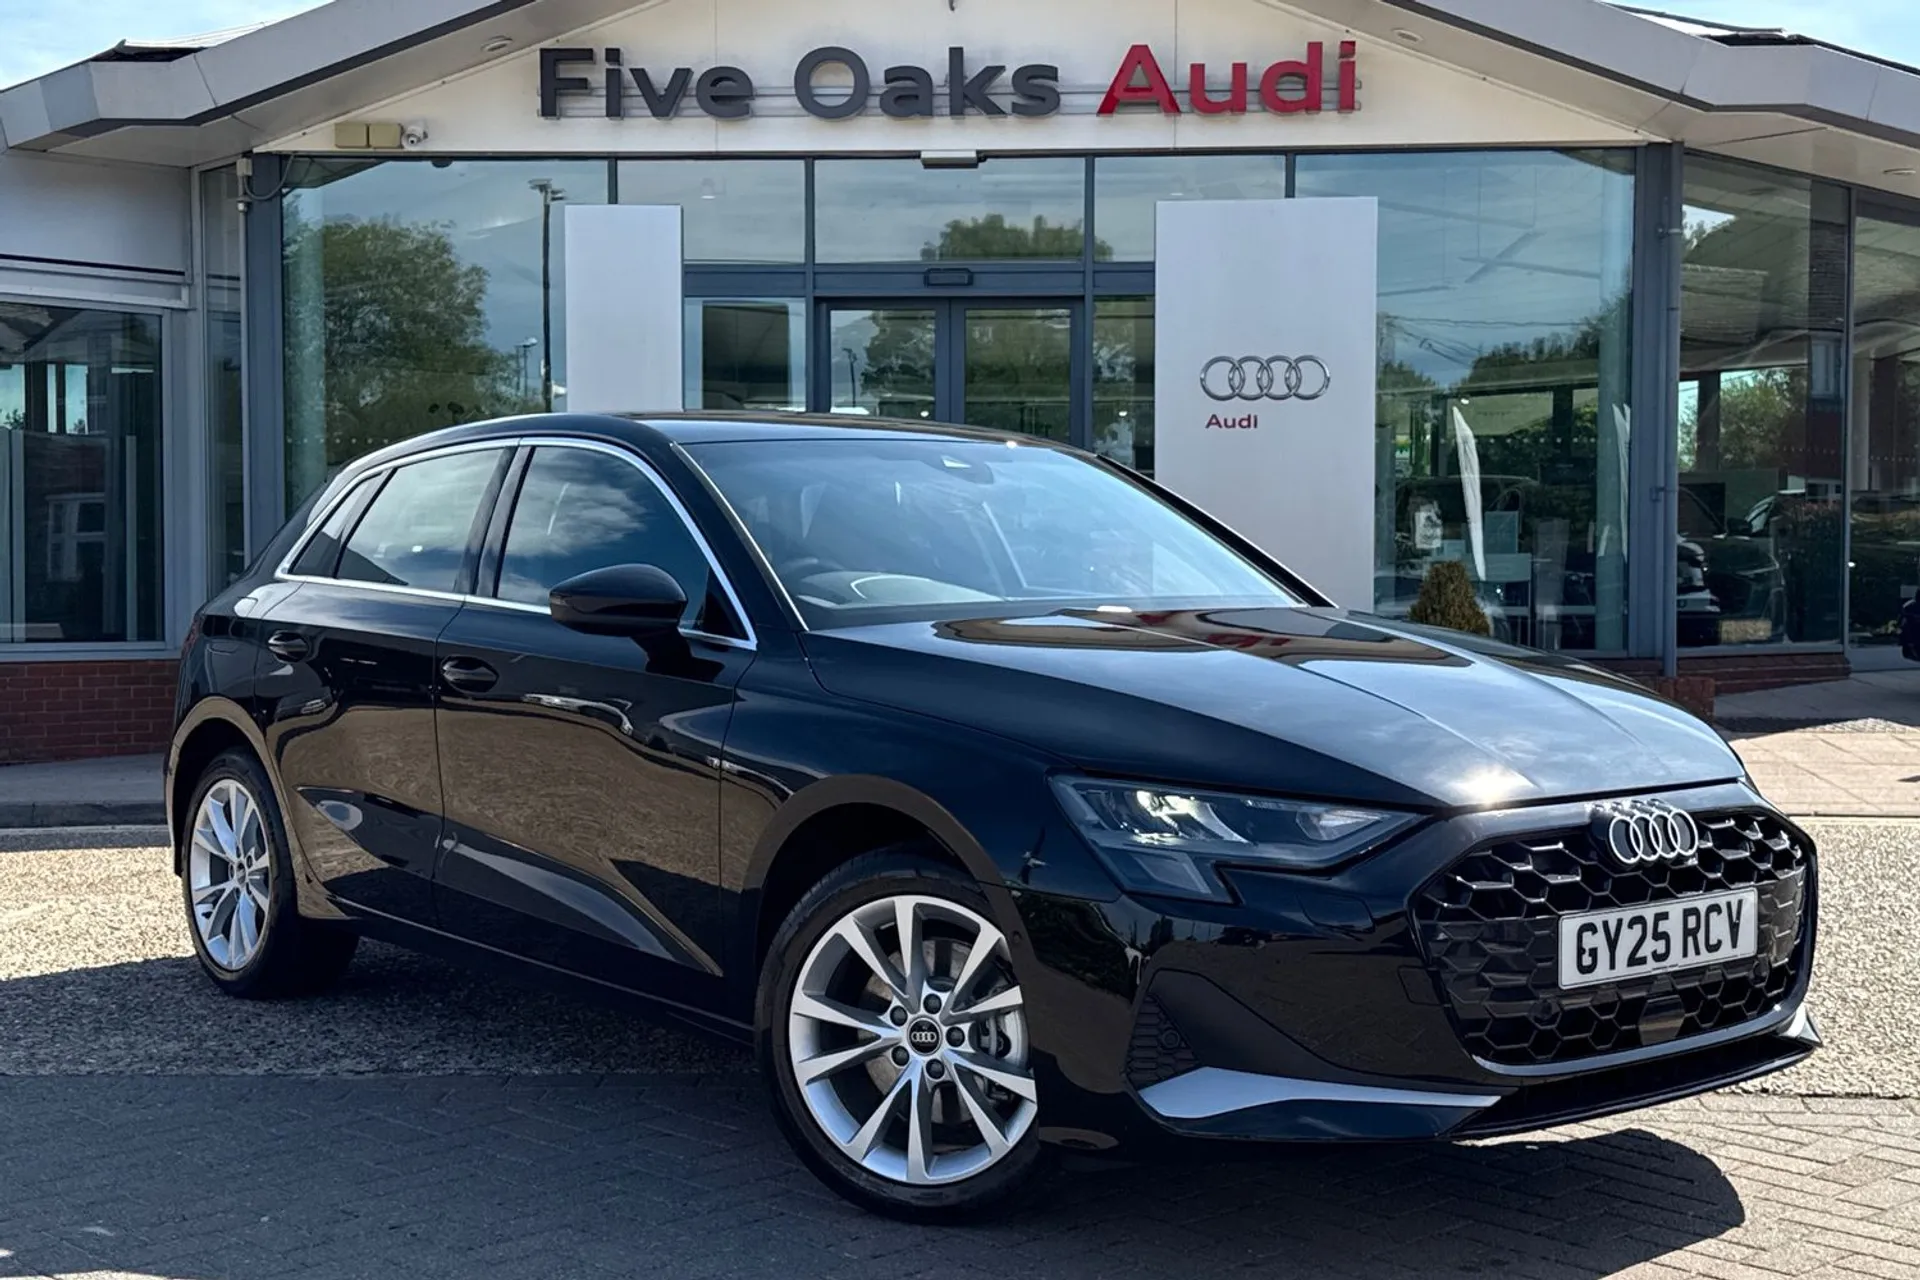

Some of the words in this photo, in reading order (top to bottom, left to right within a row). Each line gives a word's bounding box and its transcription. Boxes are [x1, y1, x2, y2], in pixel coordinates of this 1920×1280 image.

[540, 48, 753, 118] Five
[794, 46, 1061, 119] Oaks
[1096, 40, 1356, 115] Audi
[1205, 413, 1258, 429] Audi
[1576, 911, 1671, 975] GY25
[1682, 899, 1743, 959] RCV
